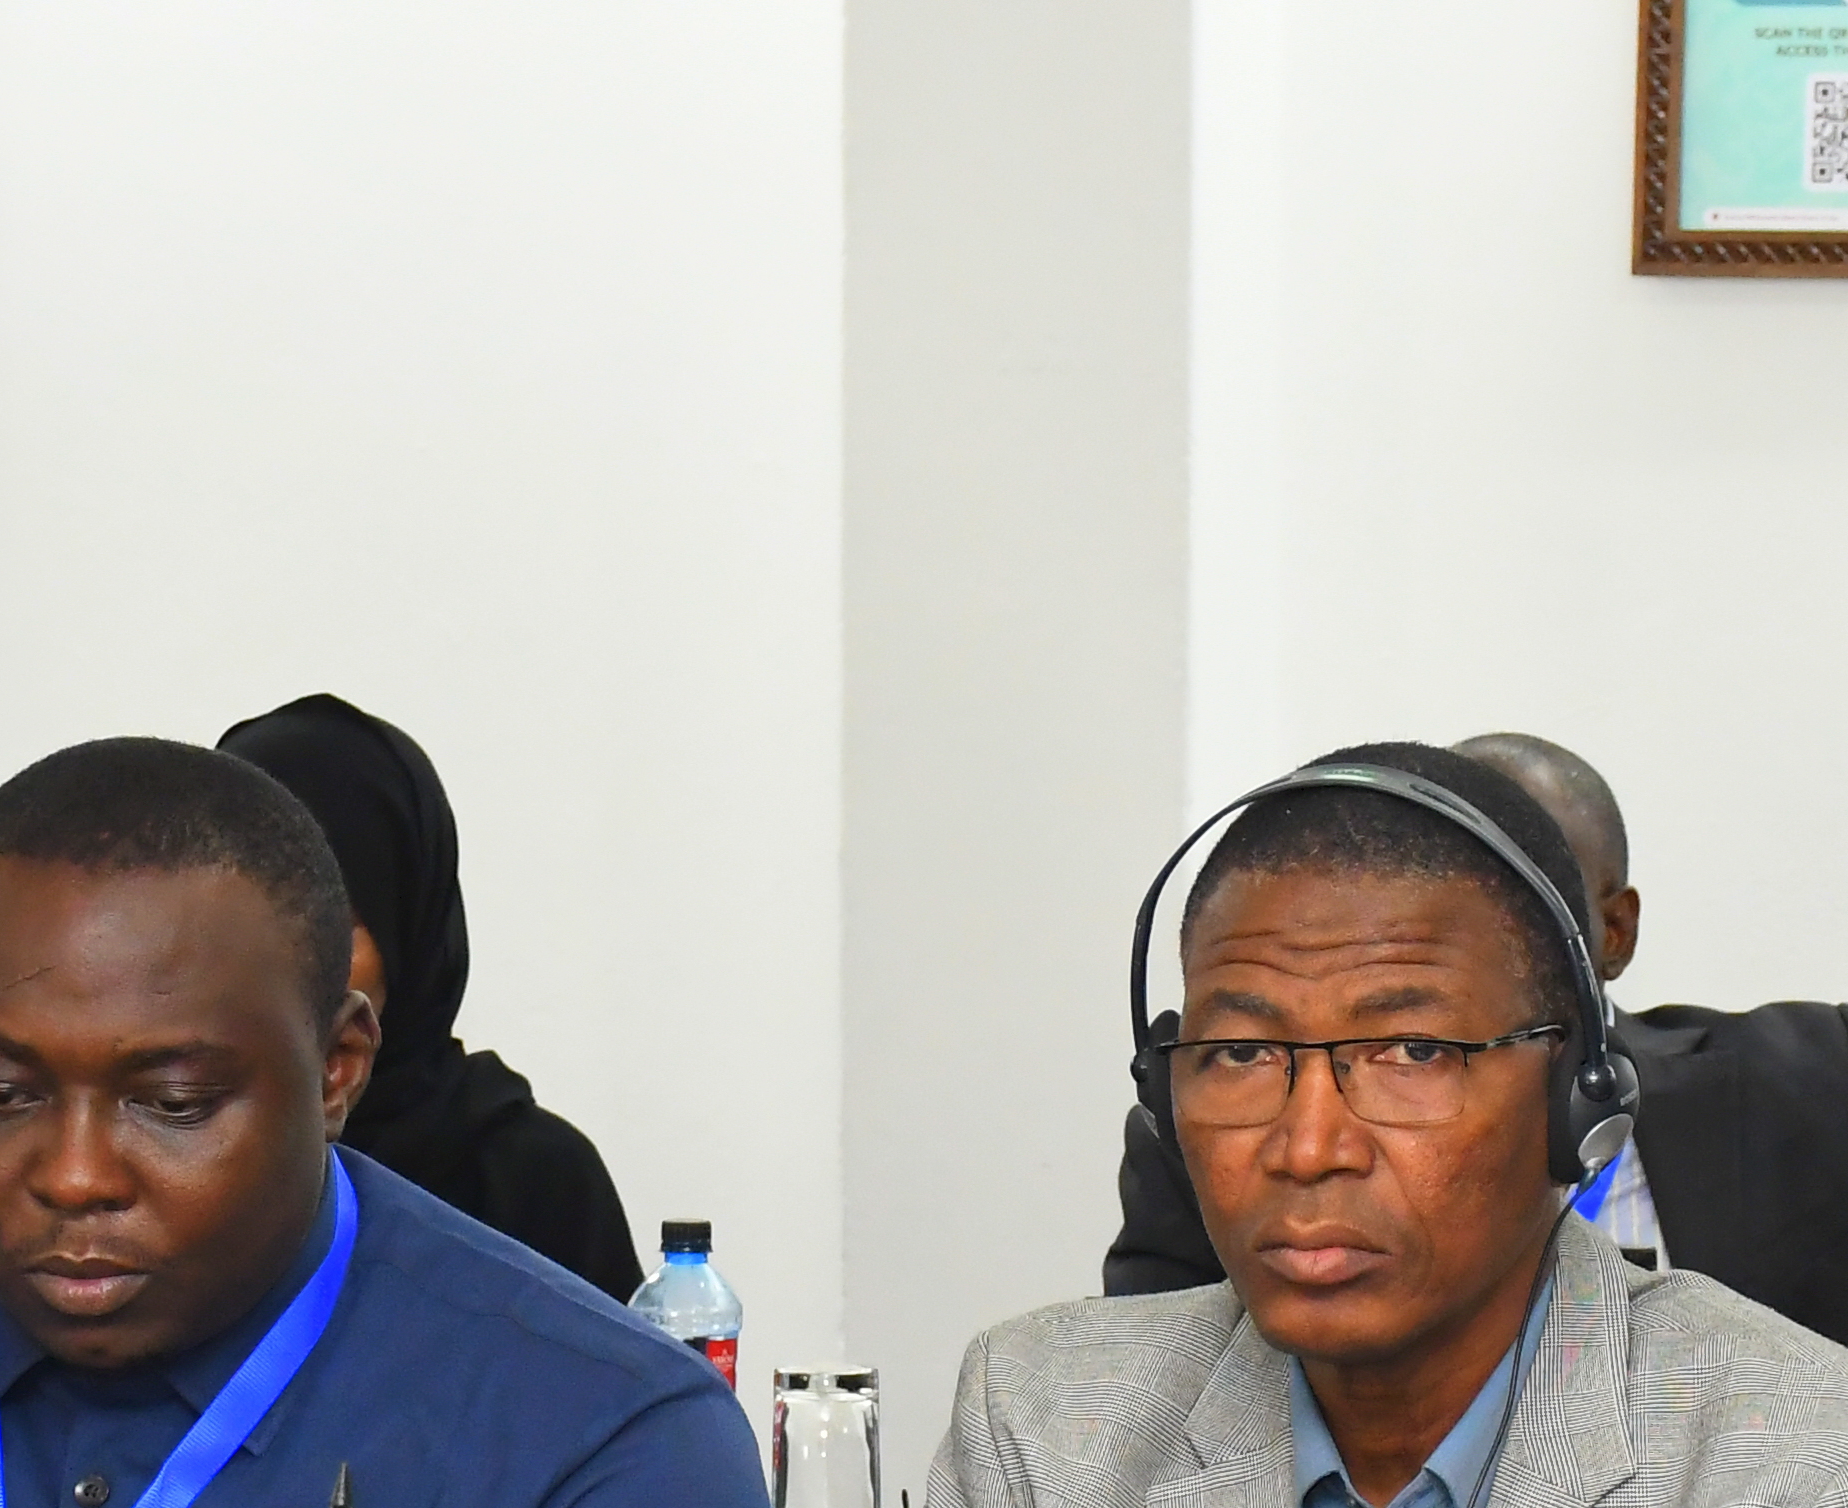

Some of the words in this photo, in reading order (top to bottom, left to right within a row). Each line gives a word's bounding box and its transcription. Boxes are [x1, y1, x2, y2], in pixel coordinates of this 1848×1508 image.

[1754, 27, 1793, 40] SCAN
[1798, 27, 1823, 40] THE
[1828, 27, 1848, 41] QR
[1776, 45, 1829, 57] ACCESS
